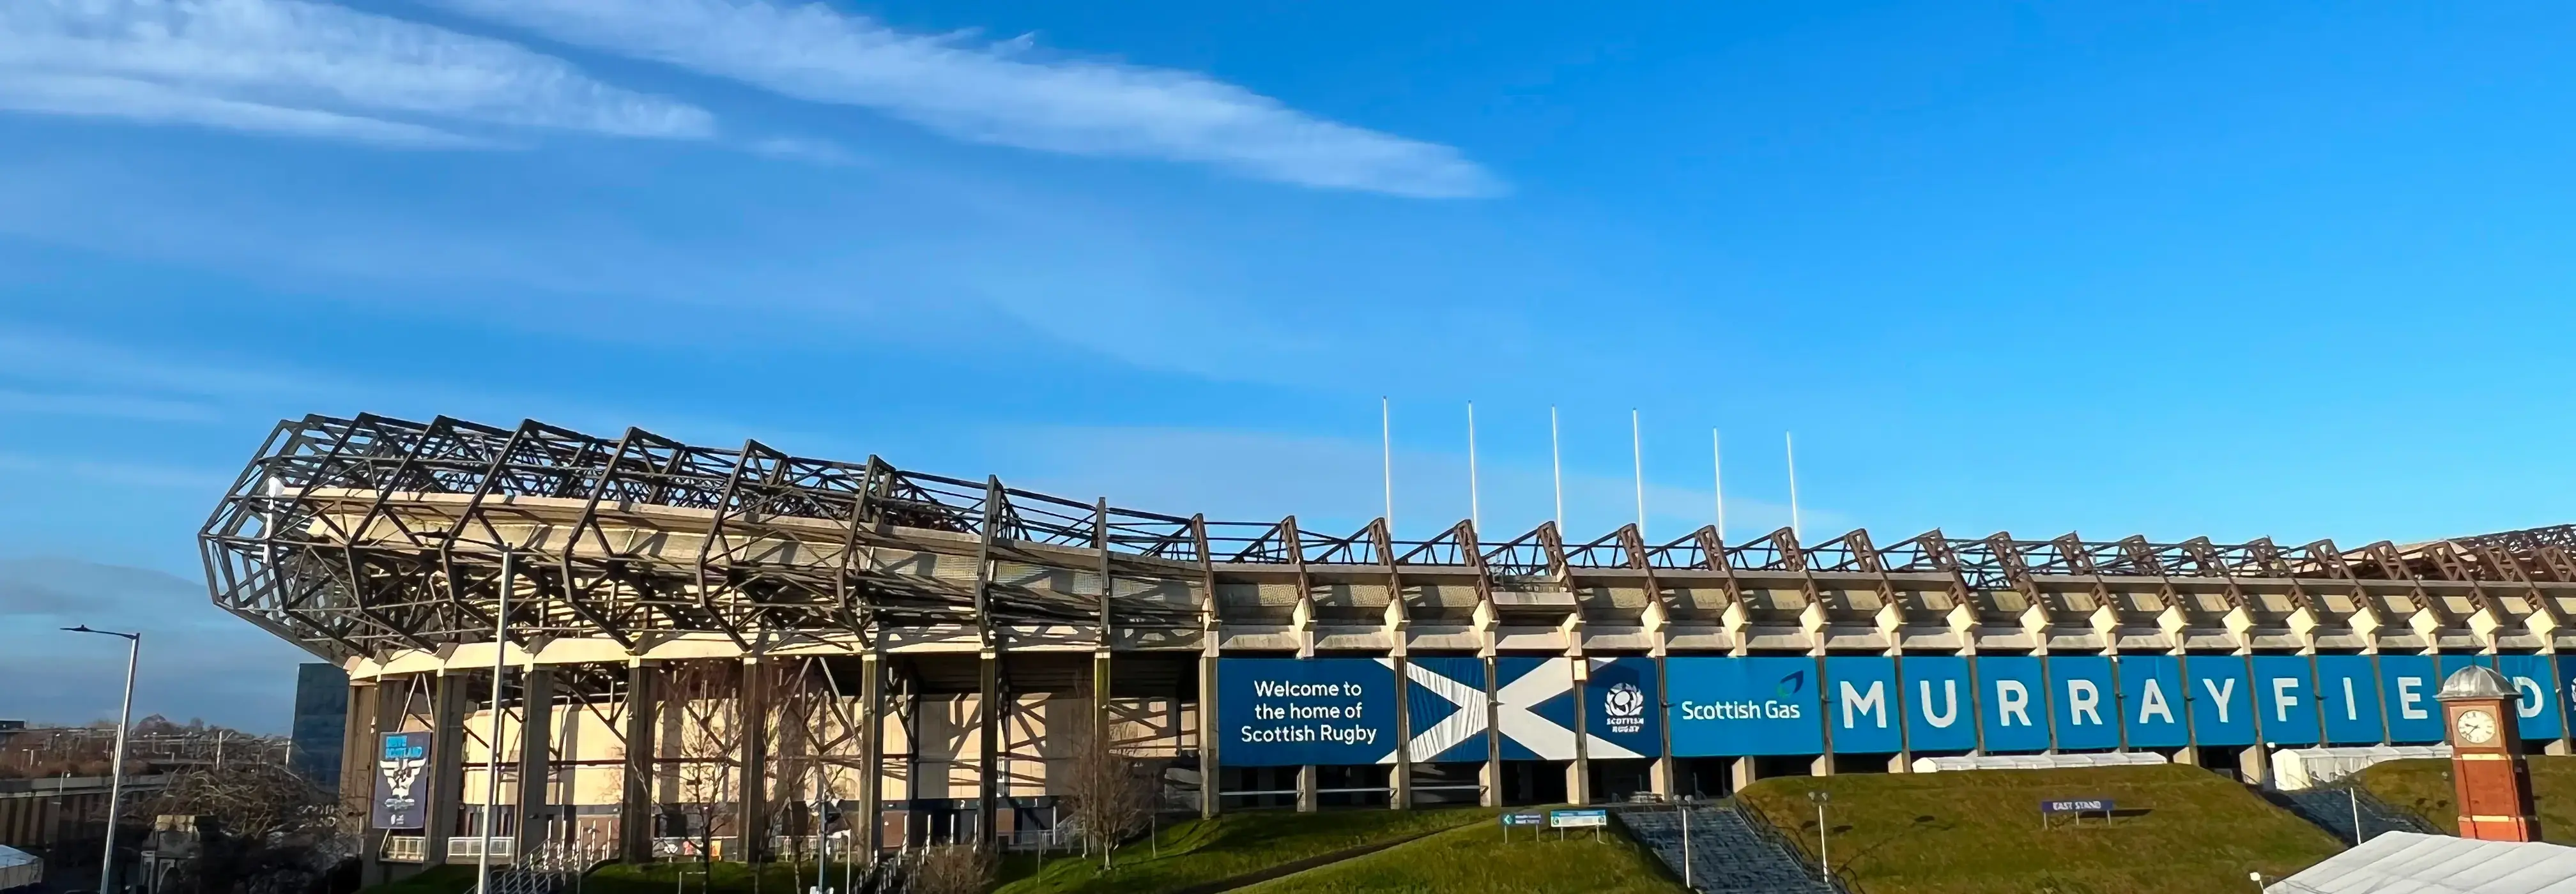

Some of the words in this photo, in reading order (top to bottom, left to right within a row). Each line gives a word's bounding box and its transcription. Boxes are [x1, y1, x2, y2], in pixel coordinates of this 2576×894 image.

[1254, 680, 1339, 697] Welcome
[1343, 681, 1362, 697] to
[1255, 703, 1285, 720] the
[1290, 702, 1340, 719] home
[1344, 702, 1363, 719] of
[1682, 701, 1761, 720] Scottish
[1765, 700, 1801, 719] Gas
[1840, 676, 2543, 729] MURRAYFIED
[1241, 725, 1315, 743] Scottish
[1321, 724, 1377, 745] Rugby
[2053, 801, 2073, 811] EAST
[2074, 800, 2101, 810] STAND
